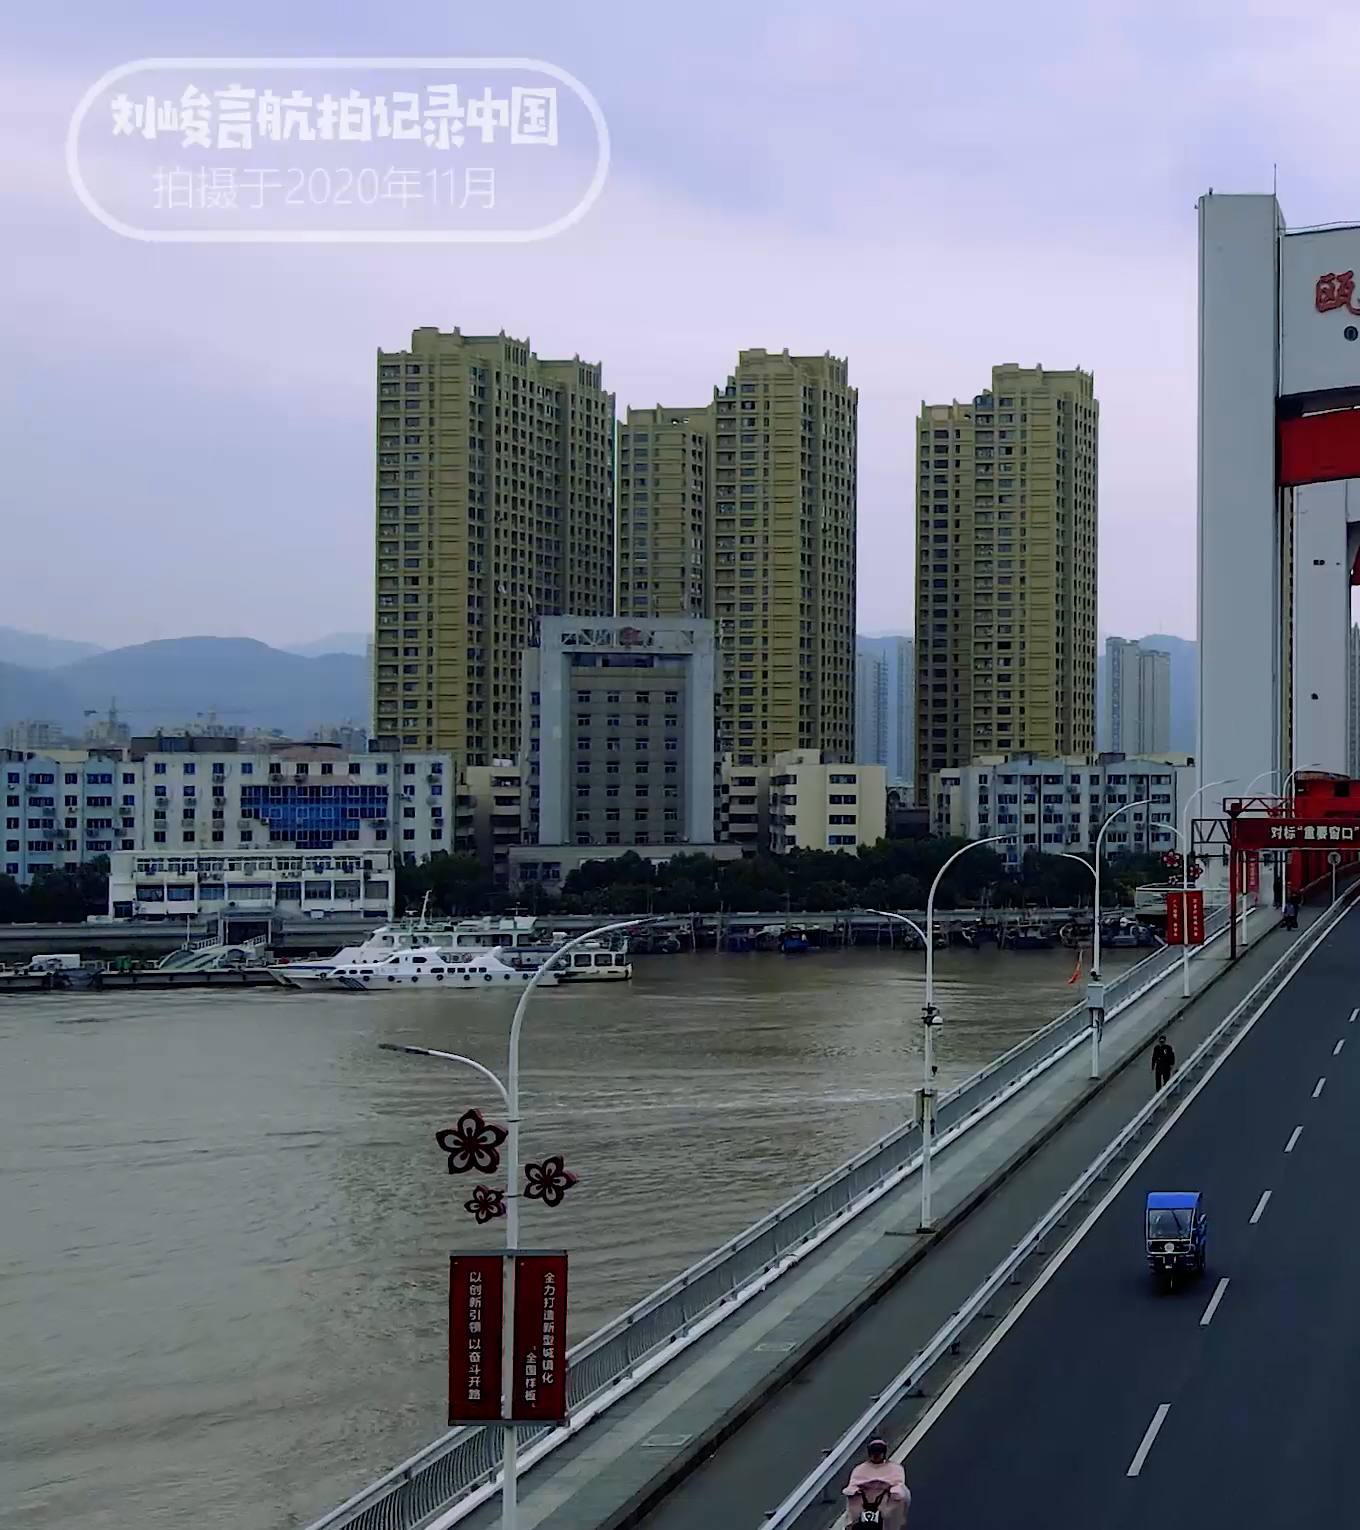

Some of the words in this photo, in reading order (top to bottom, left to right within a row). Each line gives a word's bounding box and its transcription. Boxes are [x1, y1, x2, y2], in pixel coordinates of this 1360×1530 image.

[542, 1272, 556, 1384] 全力打造新型城镇化
